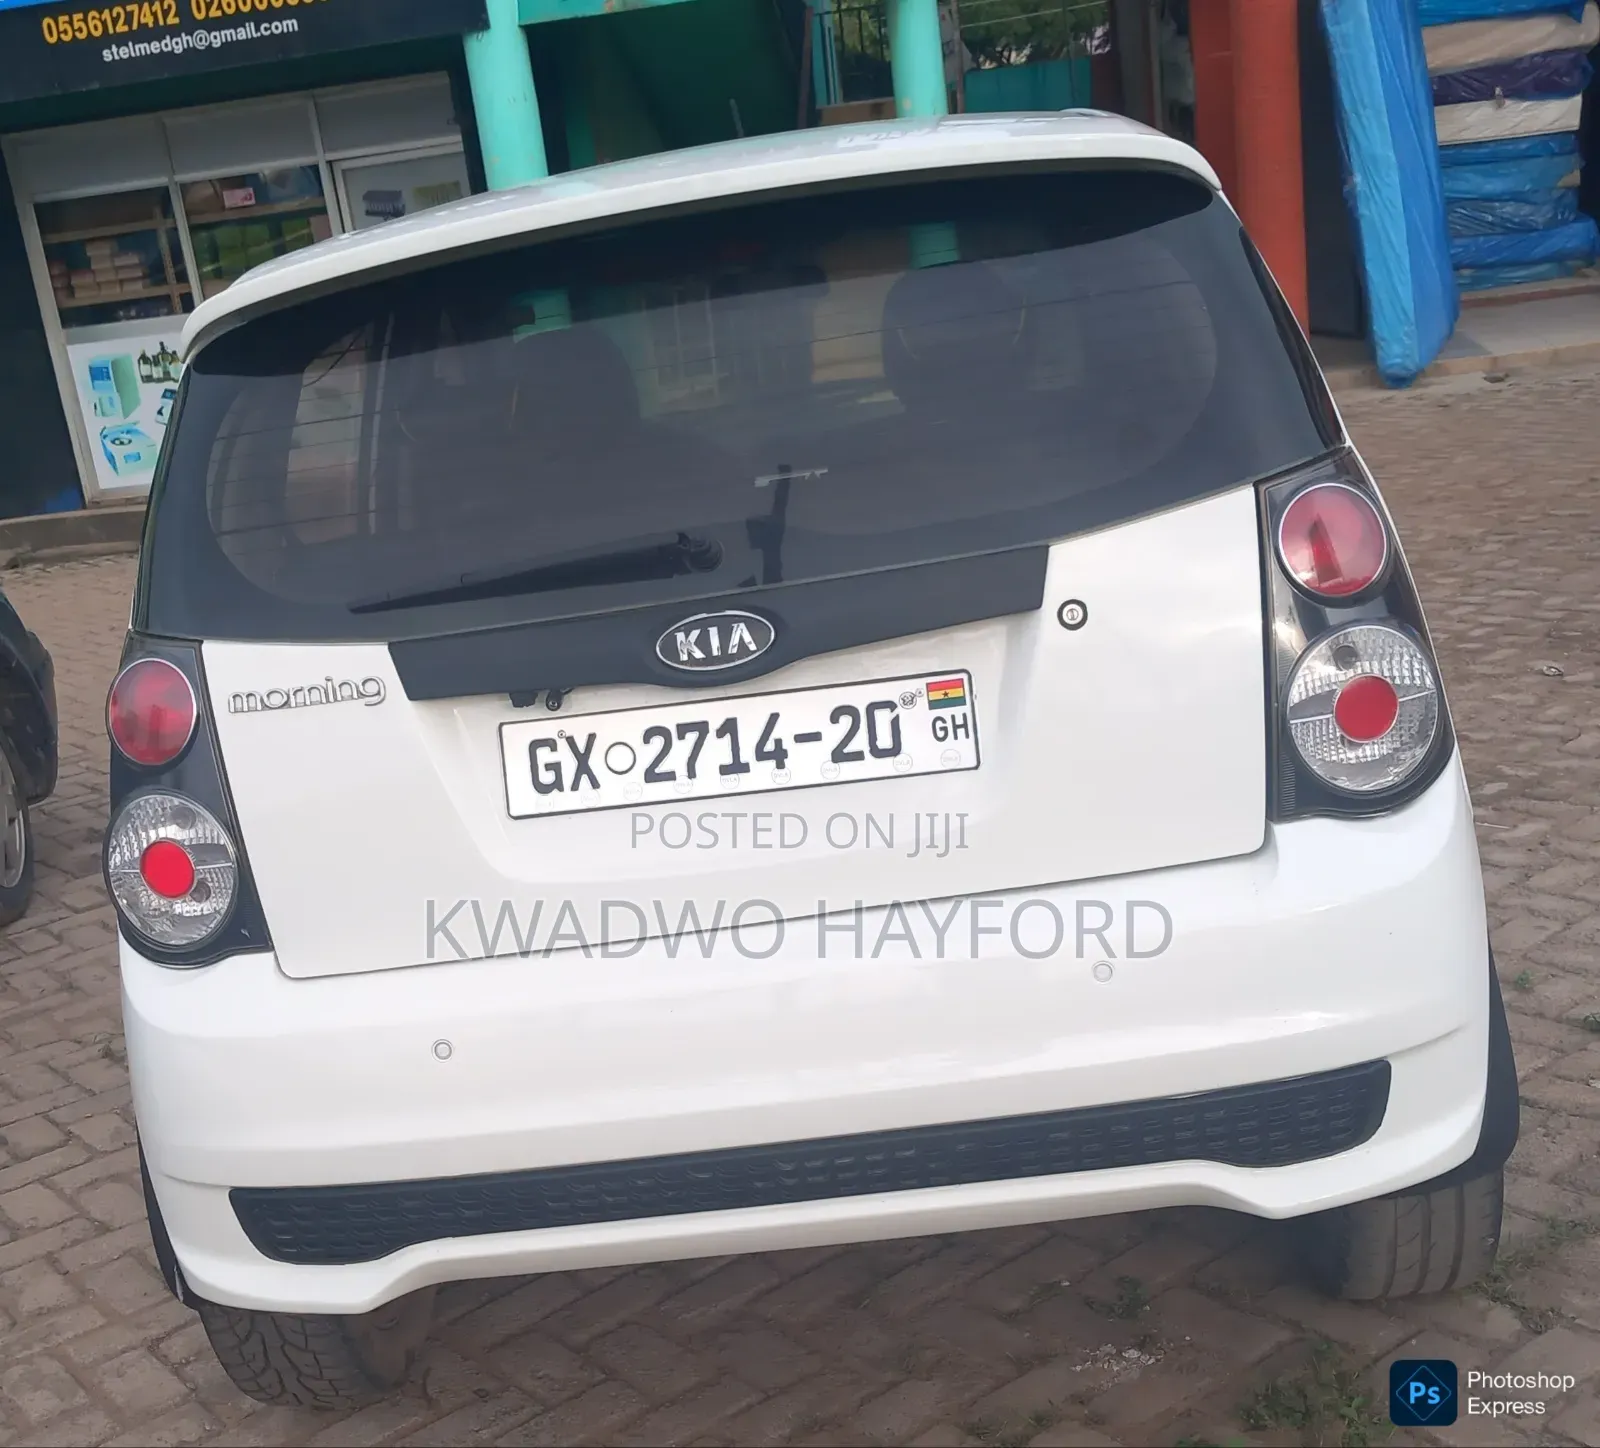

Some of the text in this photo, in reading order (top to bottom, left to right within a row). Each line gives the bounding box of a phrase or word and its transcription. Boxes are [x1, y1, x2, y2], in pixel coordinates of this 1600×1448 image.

[42, 0, 180, 44] 0556127412
[101, 18, 299, 62] stelmedgh@gmail.com
[676, 622, 758, 662] KIA
[228, 676, 386, 714] morning
[528, 700, 902, 794] GX 2714-20
[931, 712, 970, 742] GH
